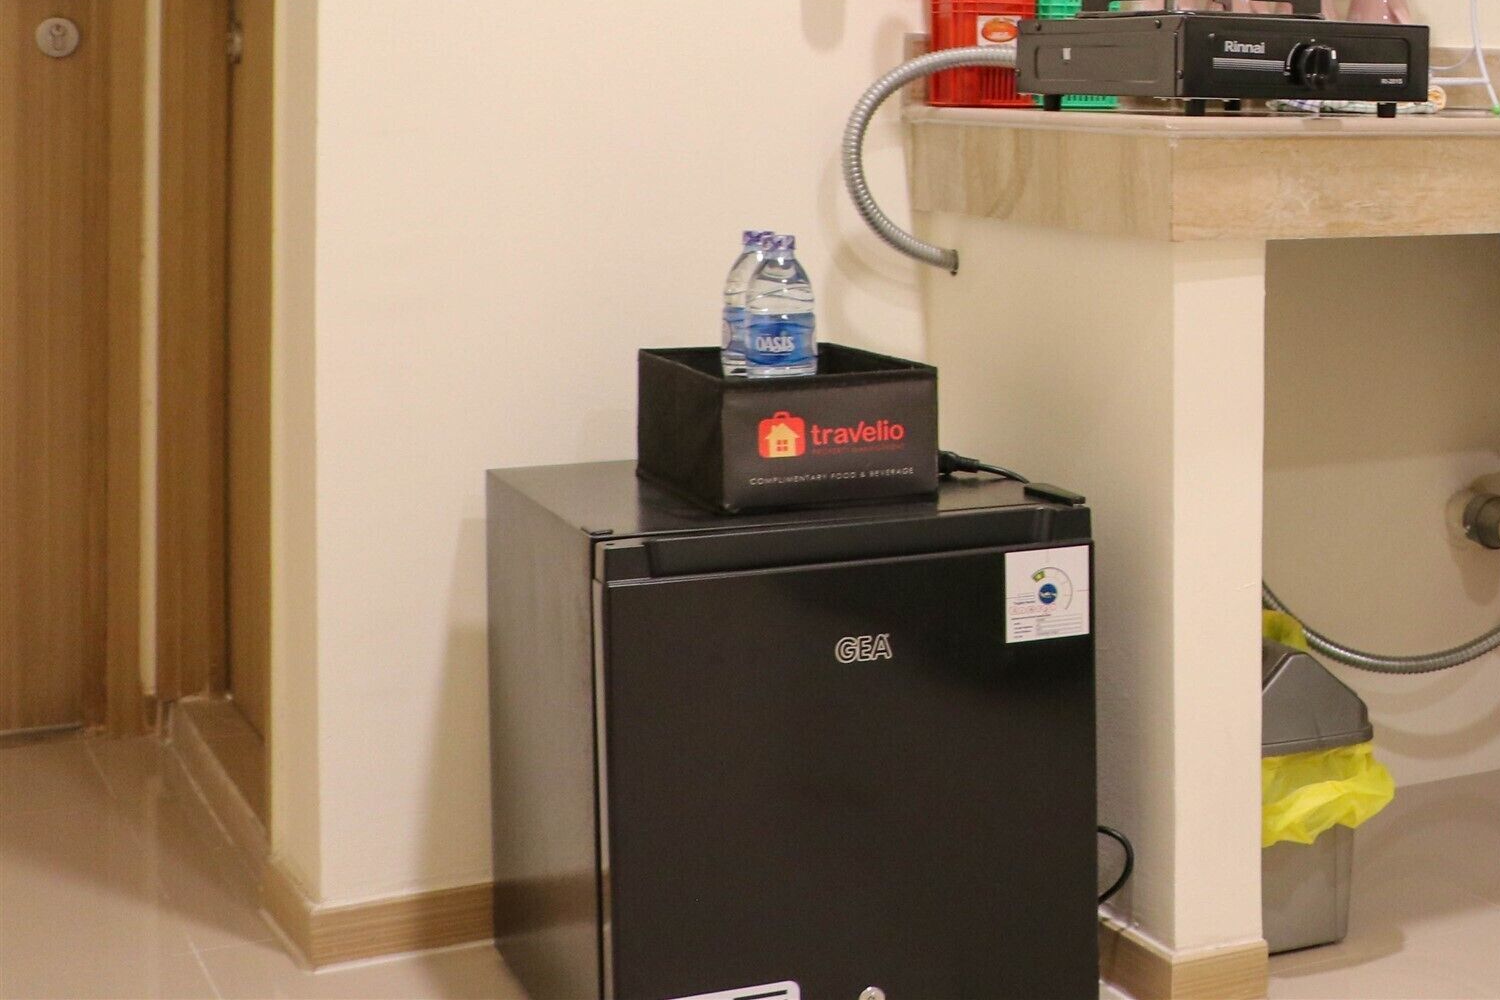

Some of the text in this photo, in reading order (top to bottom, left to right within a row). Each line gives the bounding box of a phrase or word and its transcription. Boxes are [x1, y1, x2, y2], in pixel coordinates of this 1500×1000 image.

[1223, 40, 1266, 54] Rinnai
[756, 336, 795, 353] OASIS
[810, 419, 906, 446] travelio
[749, 473, 827, 486] COMPLIMENTARY
[830, 471, 857, 480] FOOD
[869, 466, 915, 478] BEVERAGE
[834, 633, 893, 664] GEA
